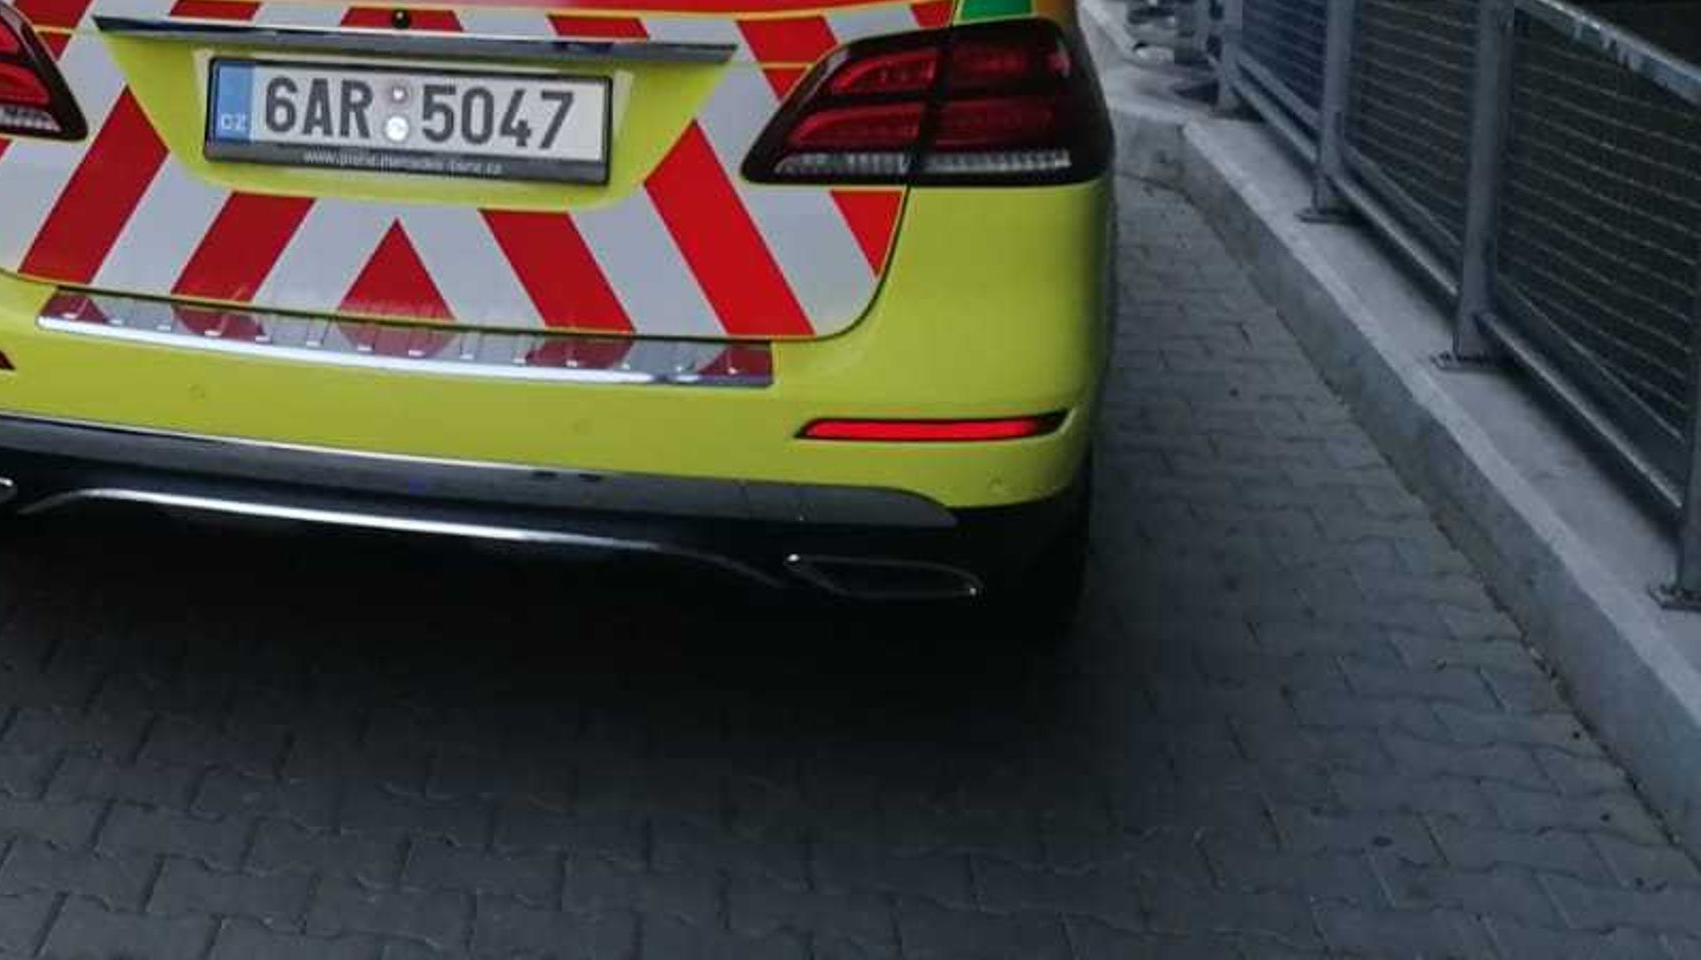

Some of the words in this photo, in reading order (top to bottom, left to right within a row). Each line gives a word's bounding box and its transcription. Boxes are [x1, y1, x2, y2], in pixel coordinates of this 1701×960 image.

[220, 113, 247, 131] CZ
[265, 76, 373, 138] 6AR
[422, 83, 574, 151] 5047
